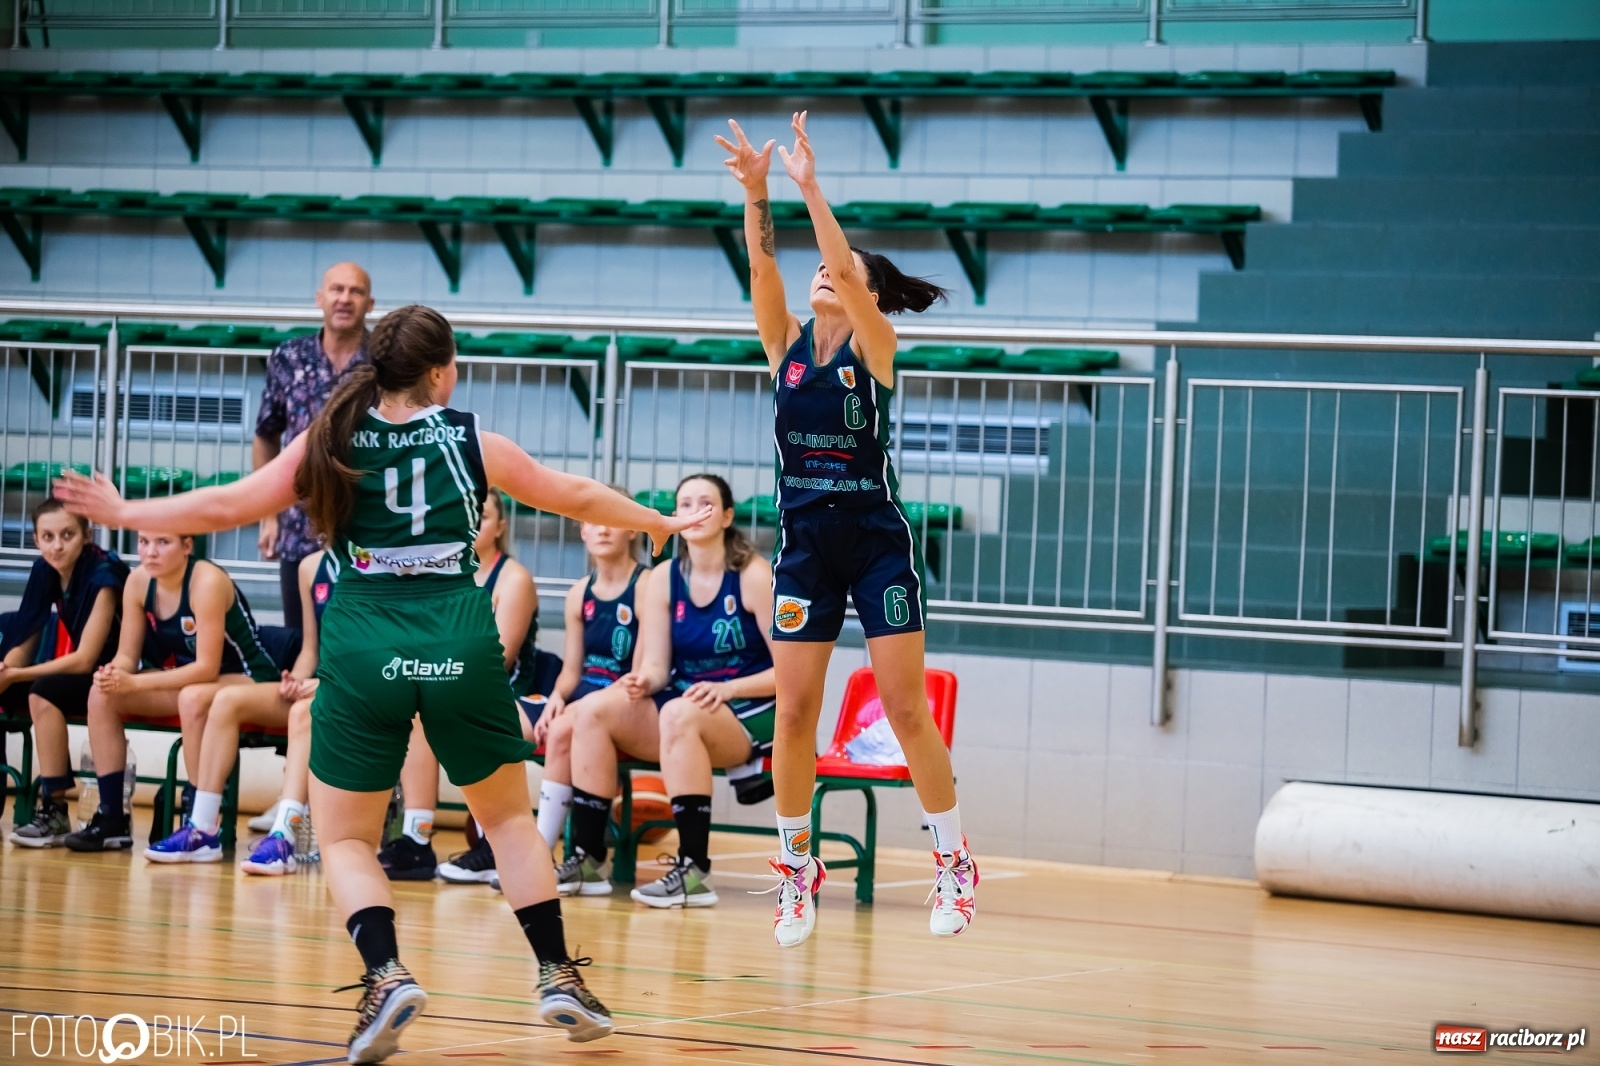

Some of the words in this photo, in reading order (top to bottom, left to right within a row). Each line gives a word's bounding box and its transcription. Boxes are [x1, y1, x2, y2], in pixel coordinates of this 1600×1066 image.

[844, 392, 867, 430] 6
[388, 425, 467, 449] RACIBORZ
[787, 431, 857, 449] OLIMPIA
[384, 457, 431, 536] 4
[783, 475, 858, 492] WODZISŁAW
[883, 585, 910, 627] 6
[611, 625, 632, 661] 9
[711, 616, 747, 654] 21
[402, 658, 465, 676] Clavis
